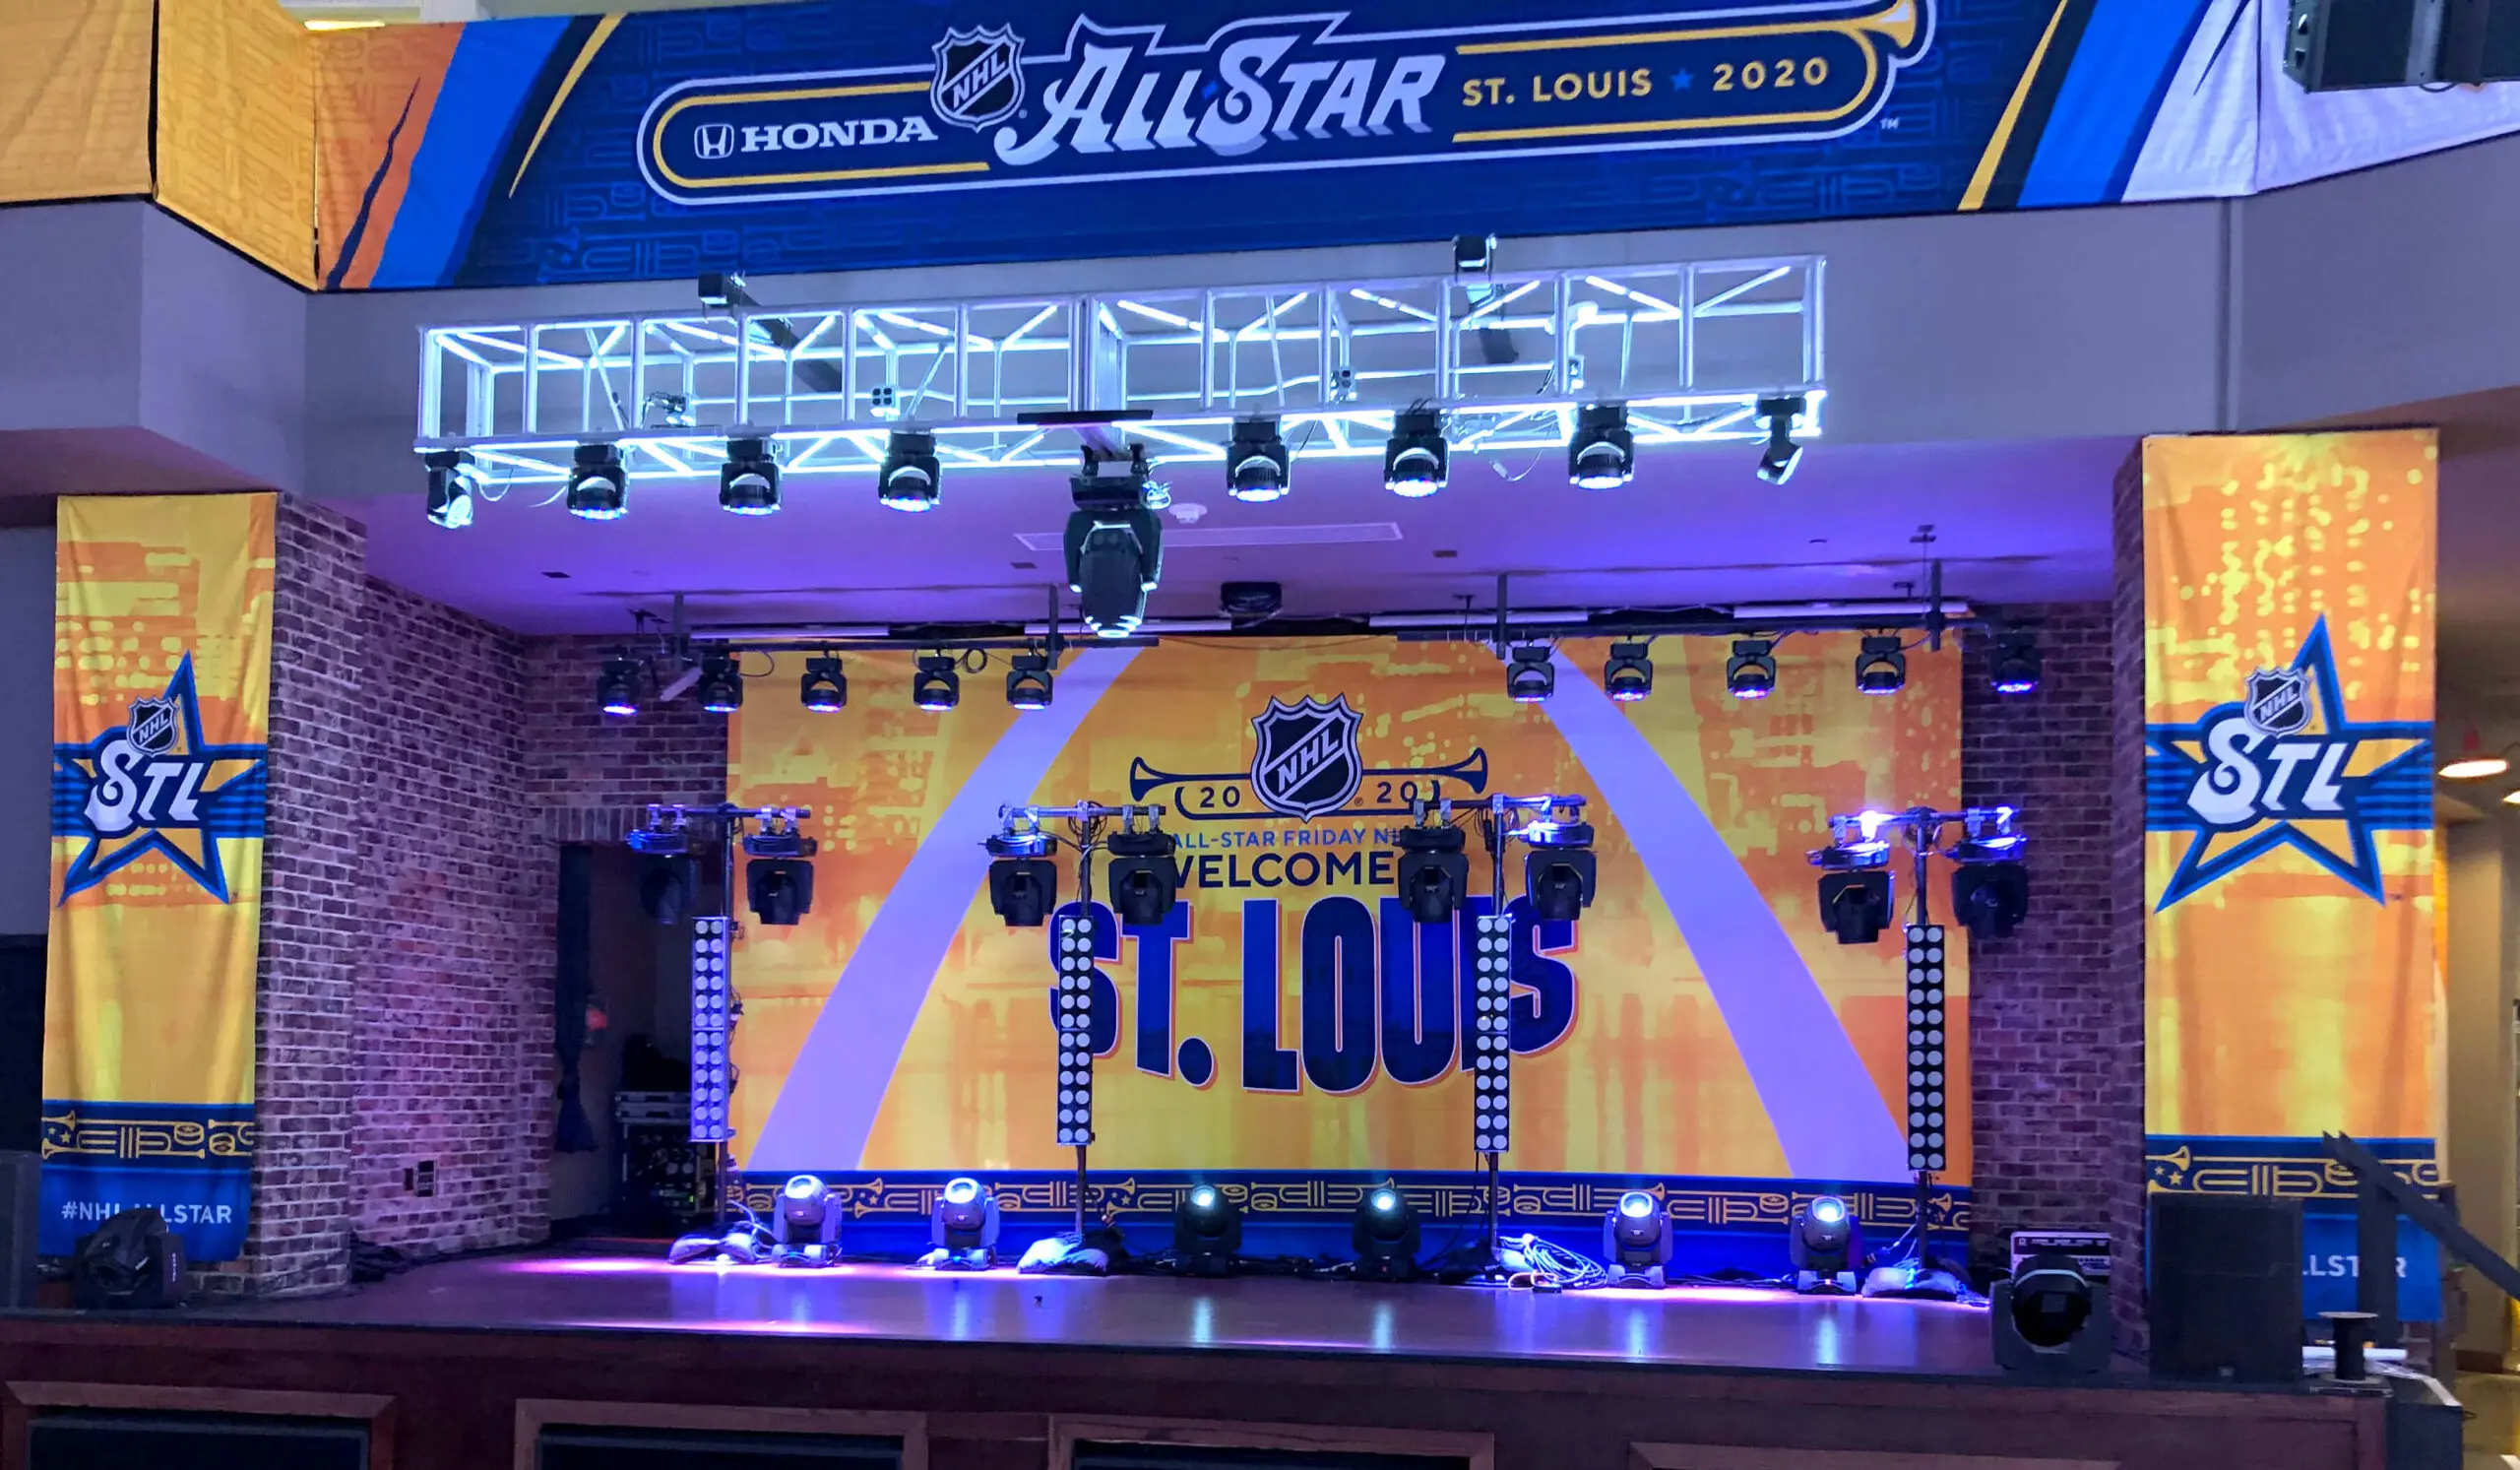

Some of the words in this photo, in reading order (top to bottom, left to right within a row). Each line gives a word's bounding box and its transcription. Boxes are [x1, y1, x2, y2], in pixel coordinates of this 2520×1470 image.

[952, 50, 1007, 109] NHL
[1462, 78, 1514, 106] ST.
[1533, 68, 1653, 102] LOUIS
[1712, 56, 1829, 93] 2020
[741, 116, 938, 153] HONDA
[2260, 686, 2298, 722] NHL
[139, 713, 169, 743] NHL
[1277, 727, 1340, 793] NHL
[2187, 717, 2348, 825] STL
[85, 738, 205, 832] STL
[1200, 786, 1240, 807] 20
[1376, 781, 1418, 803] 20
[1284, 828, 1366, 847] FRIDAY
